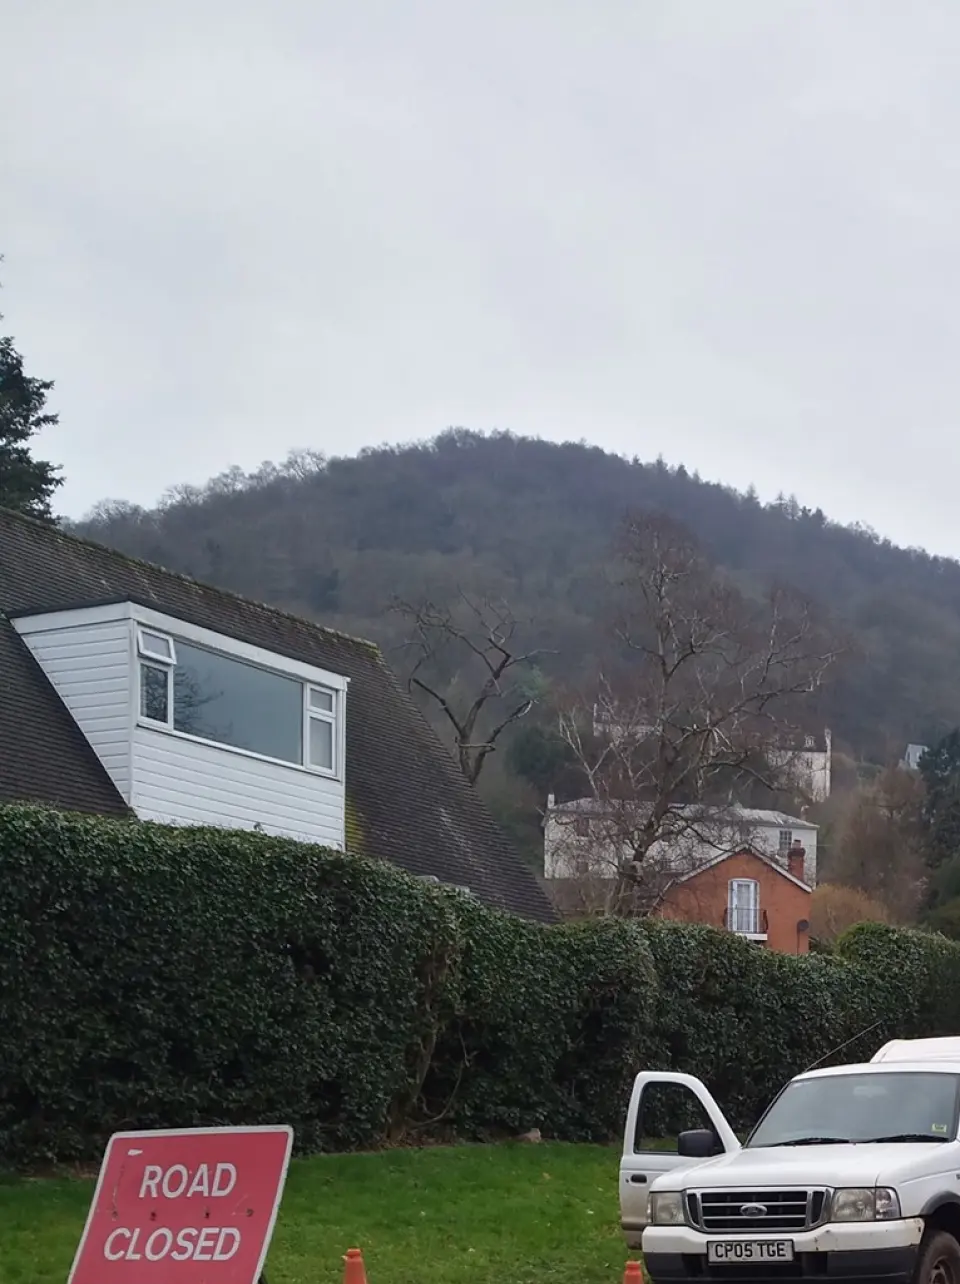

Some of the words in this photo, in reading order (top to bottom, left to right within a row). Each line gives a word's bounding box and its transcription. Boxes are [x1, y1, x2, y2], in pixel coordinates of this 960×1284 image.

[139, 1162, 237, 1199] ROAD
[103, 1227, 241, 1262] CLOSED
[715, 1243, 753, 1258] CP05
[757, 1242, 787, 1258] TGE
